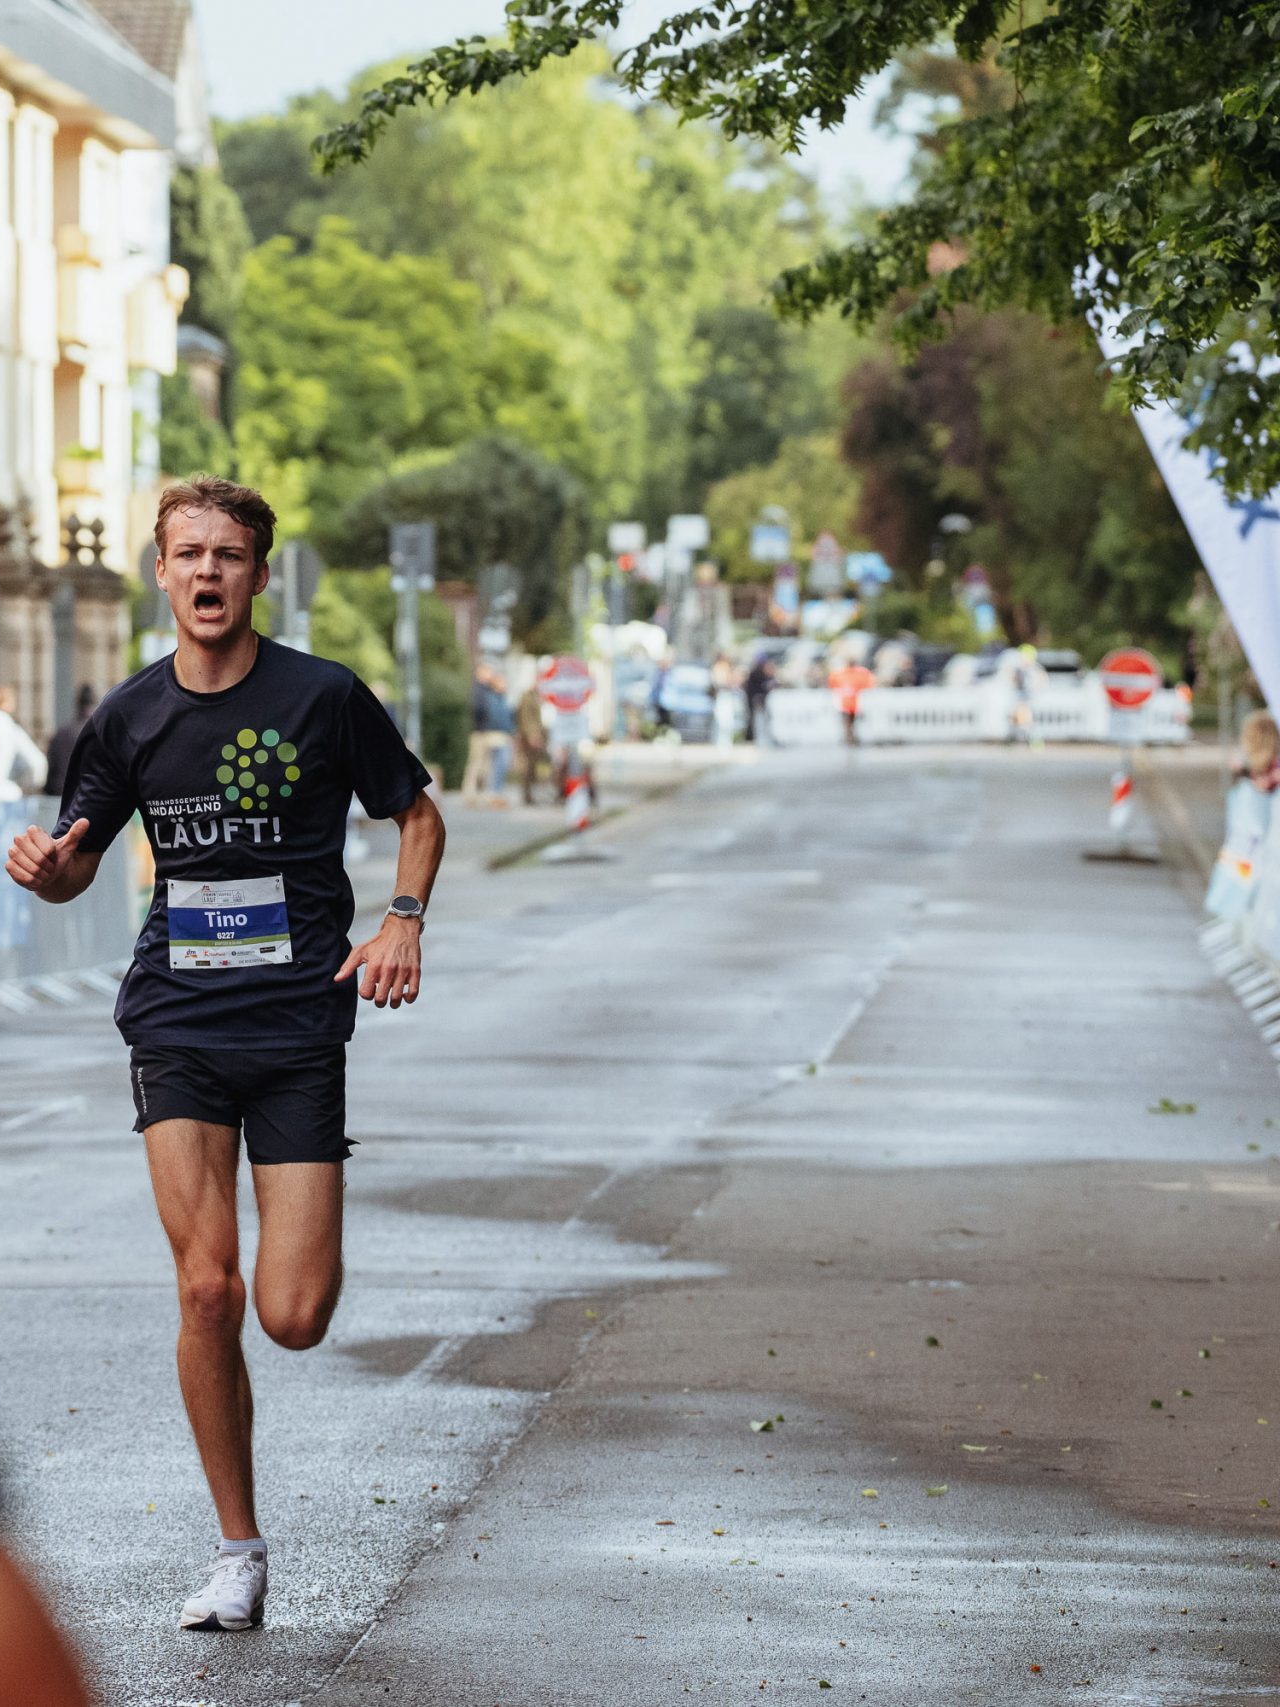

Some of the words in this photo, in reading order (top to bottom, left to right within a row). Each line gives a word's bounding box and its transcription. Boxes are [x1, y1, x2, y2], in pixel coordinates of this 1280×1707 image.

[146, 795, 220, 806] VERBANDSGEMEINDE
[149, 802, 221, 816] ANDAU-LAND
[154, 817, 282, 848] LÄUFT!
[204, 911, 248, 927] Tino
